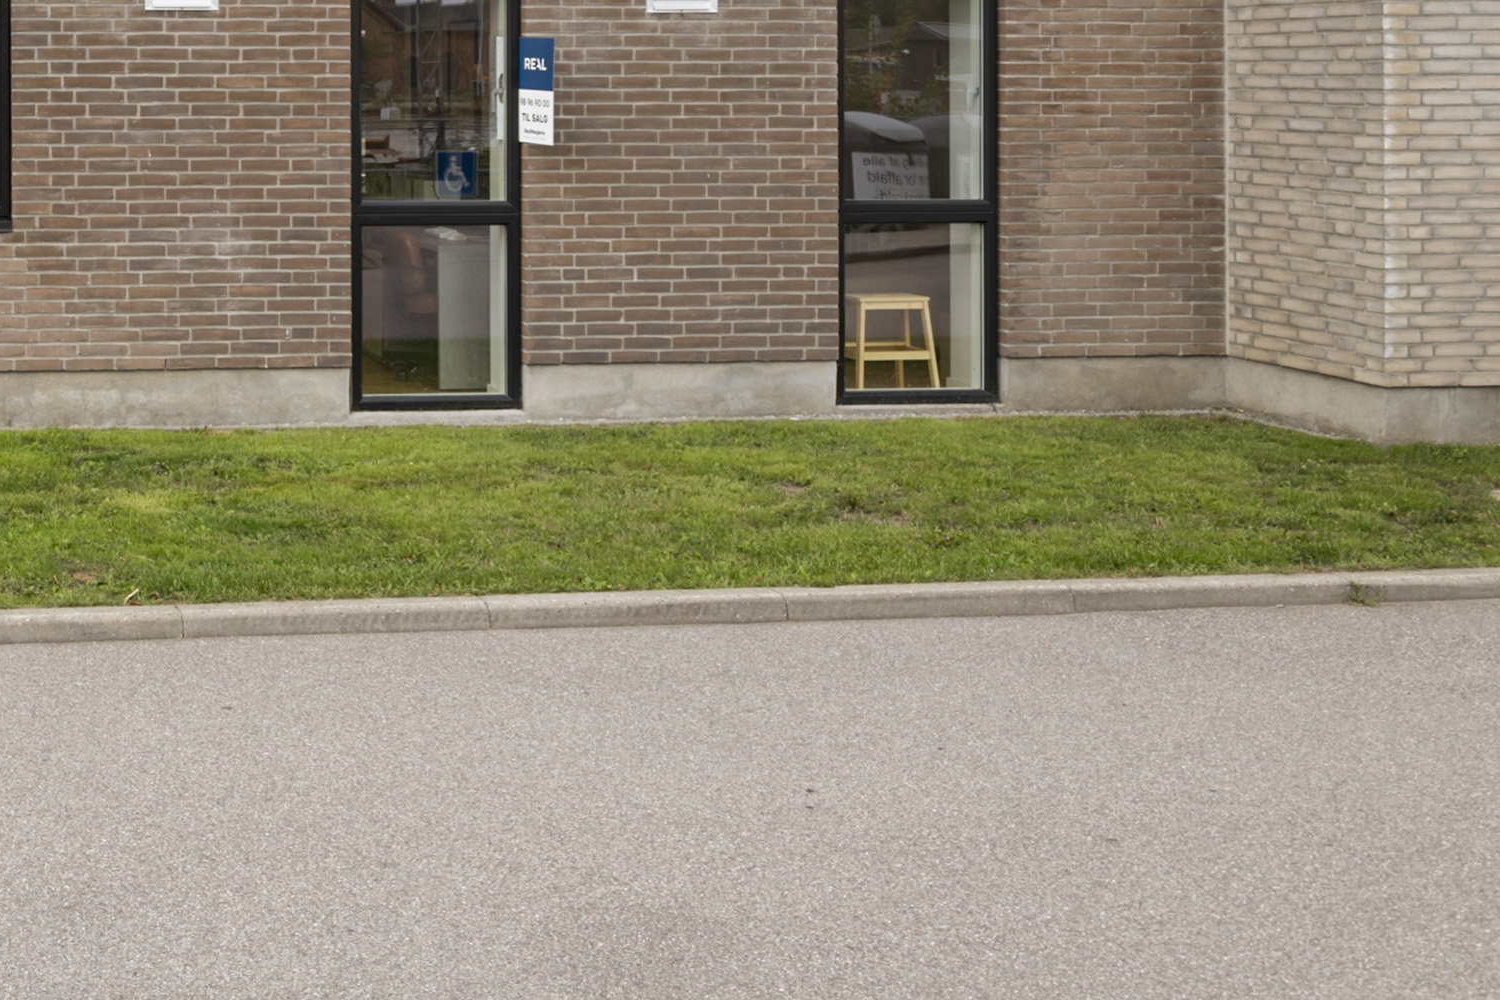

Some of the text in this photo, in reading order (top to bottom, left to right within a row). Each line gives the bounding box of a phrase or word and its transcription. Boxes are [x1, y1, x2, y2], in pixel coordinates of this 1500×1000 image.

[523, 57, 547, 71] REAL
[522, 112, 548, 124] TIL SALG
